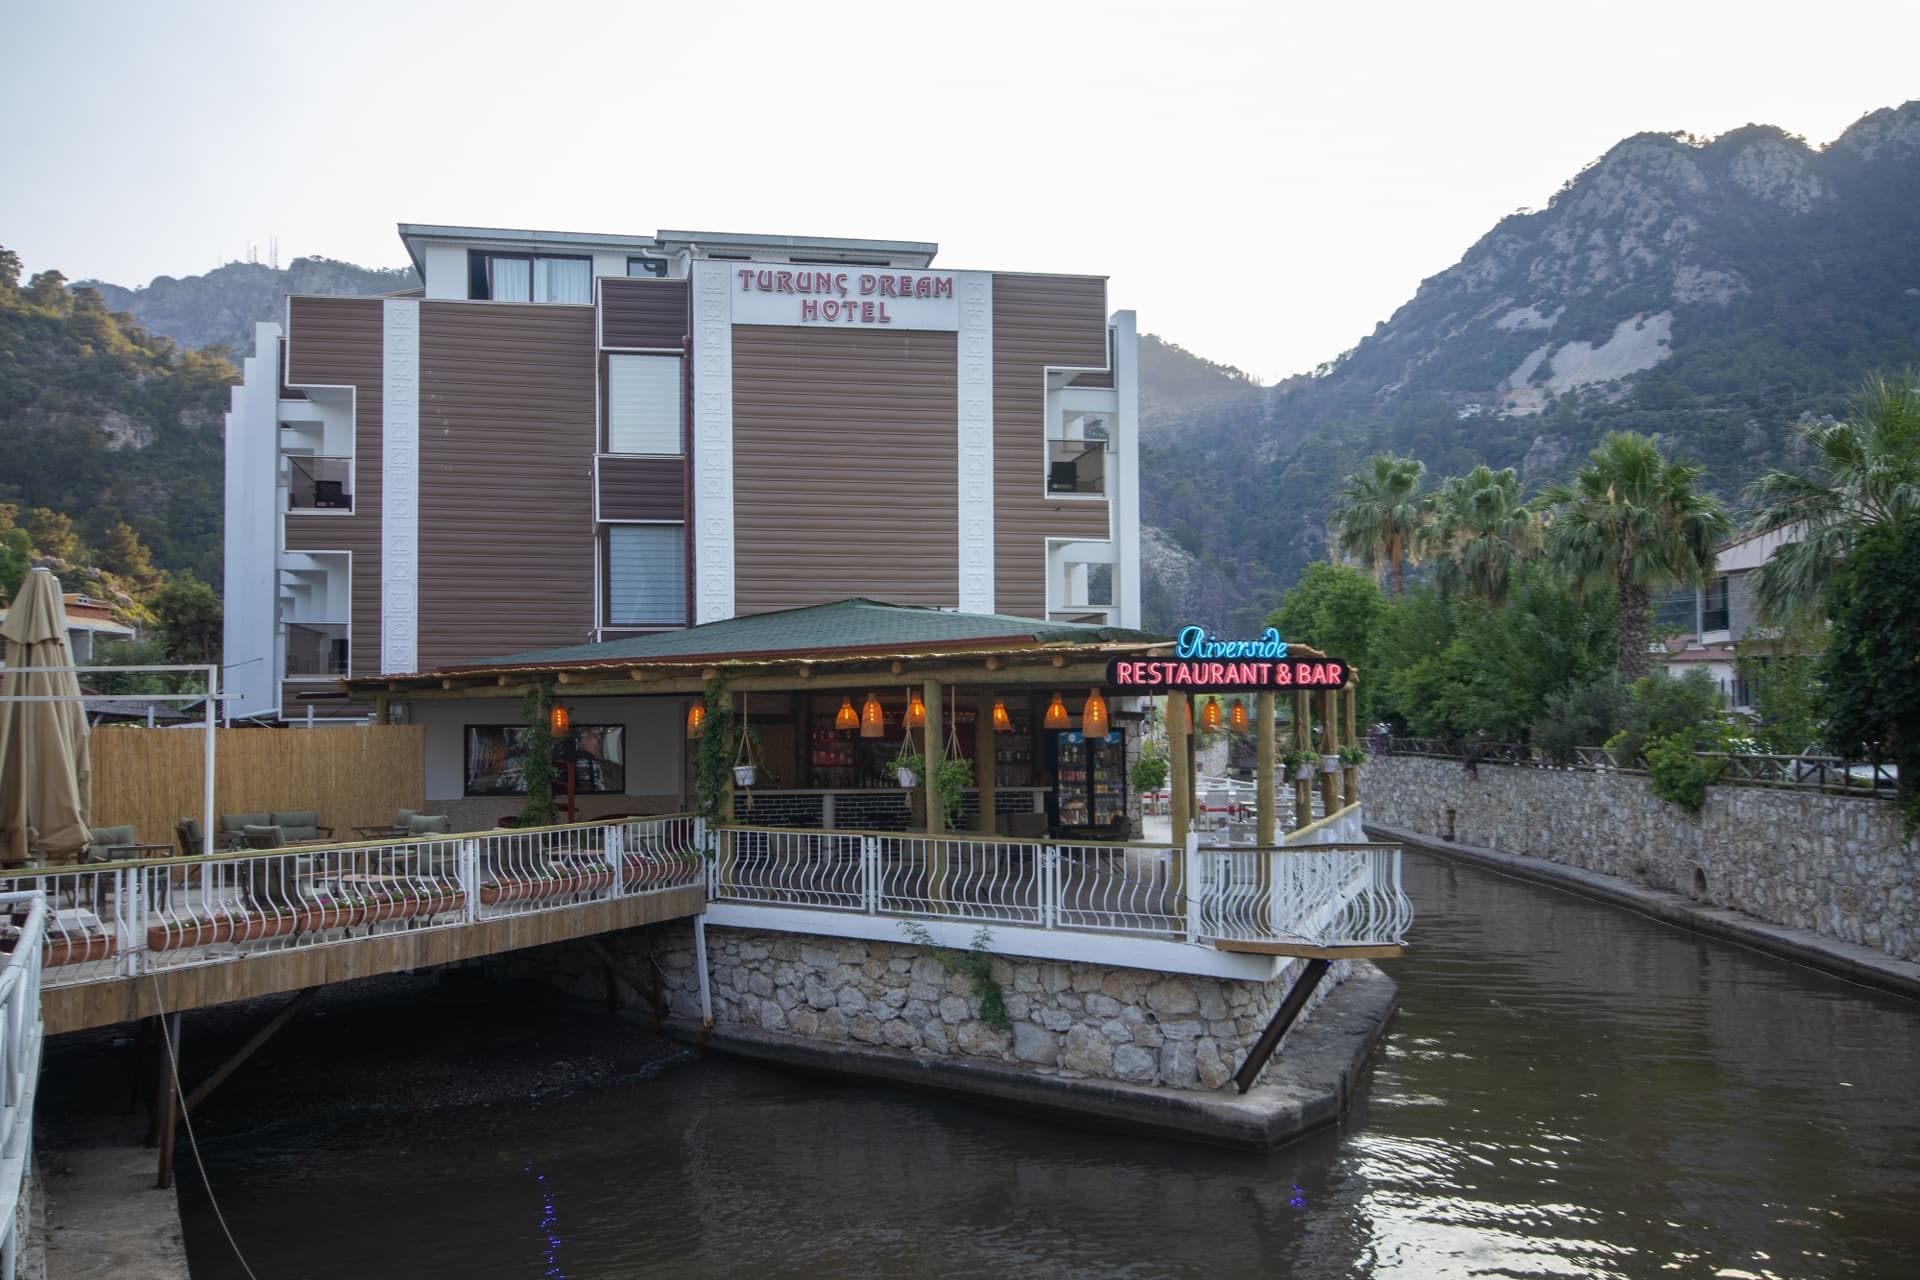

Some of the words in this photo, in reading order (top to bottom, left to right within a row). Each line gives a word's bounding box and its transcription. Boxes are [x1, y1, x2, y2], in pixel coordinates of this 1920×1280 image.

[738, 269, 849, 297] TURUNÇ
[859, 274, 953, 298] DREAM
[801, 299, 891, 322] HOTEL
[1176, 625, 1288, 658] Riverside
[1116, 662, 1272, 685] RESTAURANT
[1276, 663, 1292, 685] &
[1297, 663, 1342, 685] BAR
